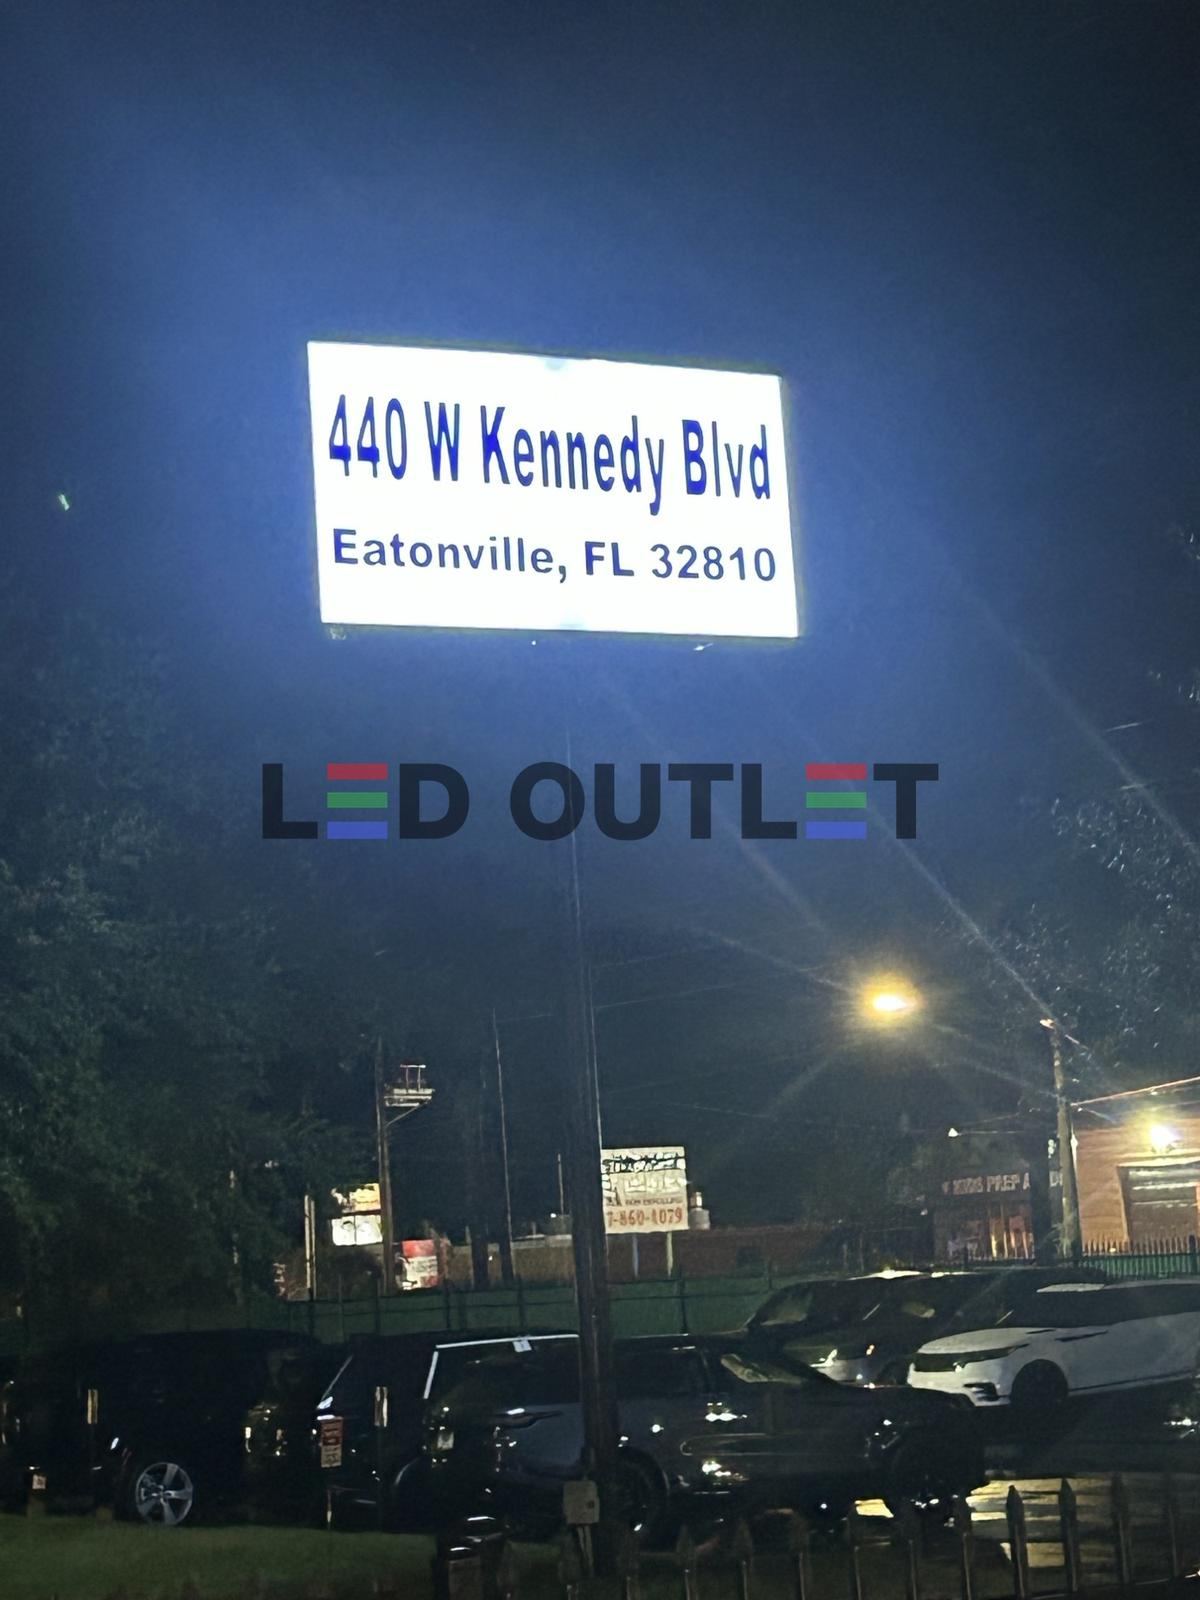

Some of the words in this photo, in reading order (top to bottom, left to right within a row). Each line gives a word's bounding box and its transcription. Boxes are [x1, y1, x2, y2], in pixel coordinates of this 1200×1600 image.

[329, 394, 408, 480] 440
[424, 401, 460, 481] W
[480, 405, 665, 516] Kennedy
[682, 419, 771, 499] Blvd
[333, 528, 567, 583] Eatonville,
[584, 540, 635, 577] FL
[650, 543, 776, 582] 32810
